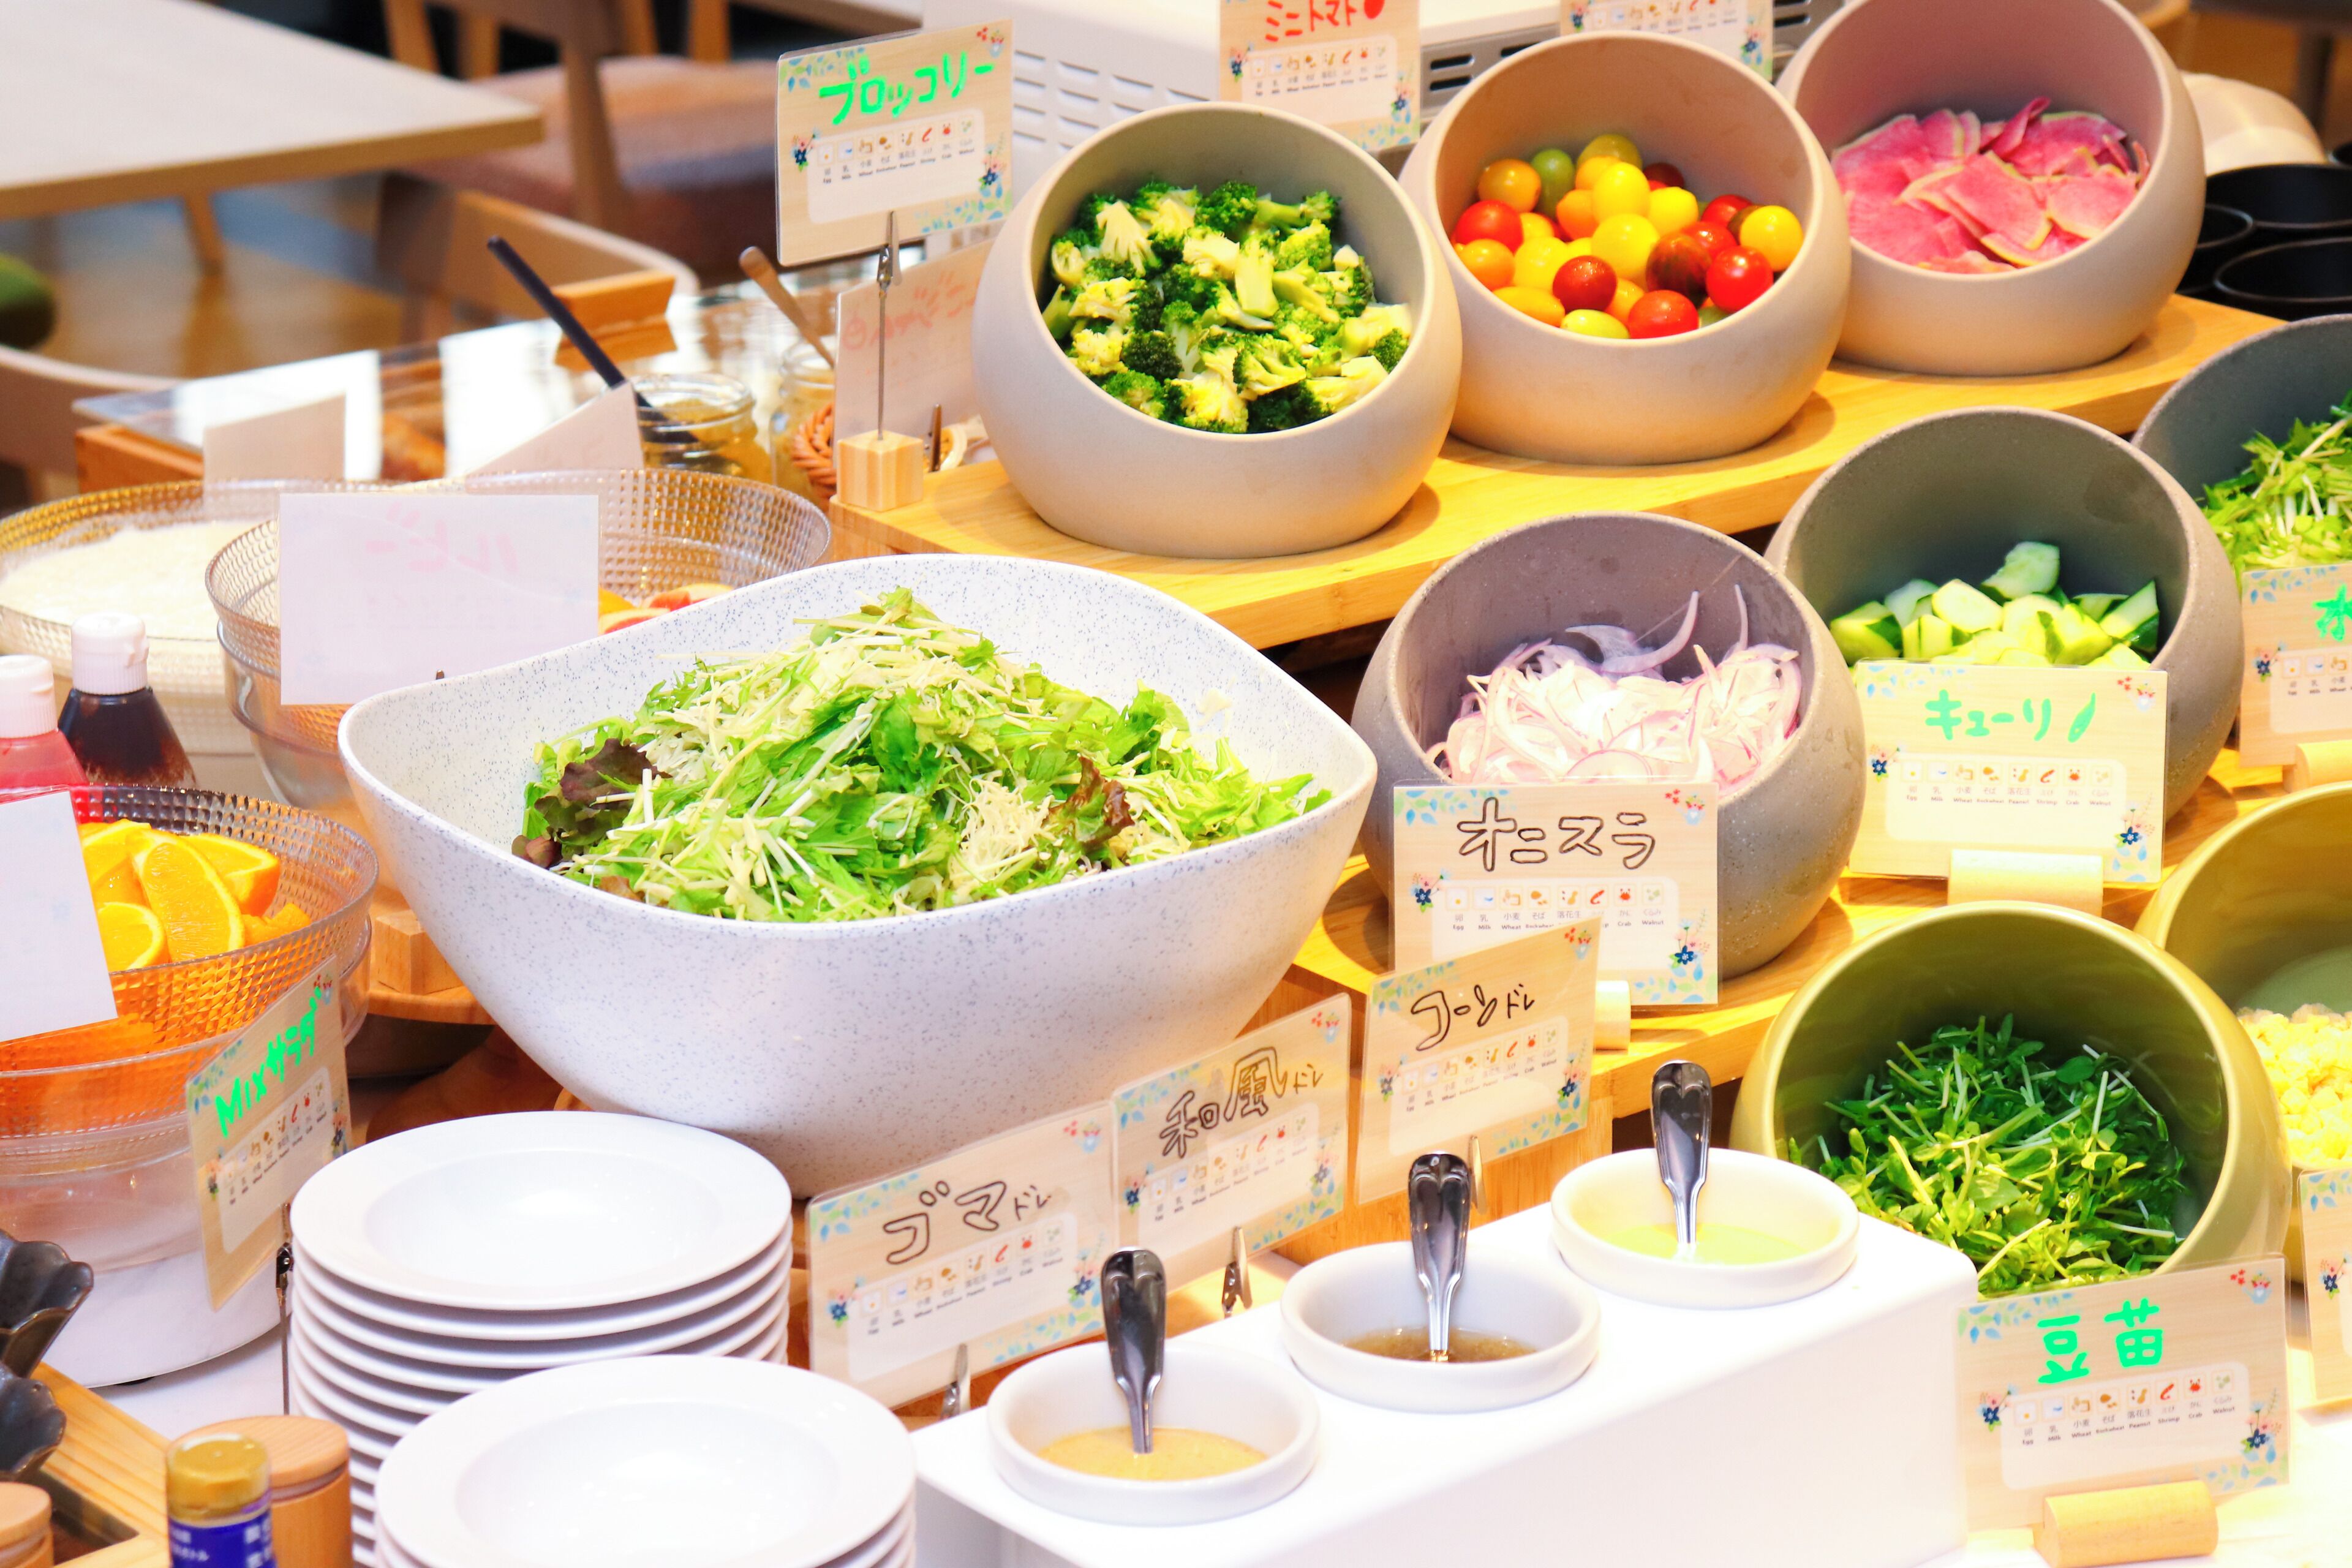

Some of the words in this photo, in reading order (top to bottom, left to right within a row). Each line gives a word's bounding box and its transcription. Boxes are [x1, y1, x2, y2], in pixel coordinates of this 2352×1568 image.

[818, 51, 995, 125] ブロッコリー
[1925, 689, 2052, 741] キューリ
[1457, 796, 1656, 872] オニスラ
[2035, 1297, 2165, 1385] 豆苗
[2071, 1430, 2092, 1439] Wheat
[2128, 1420, 2151, 1429] Peanut
[2158, 1415, 2180, 1425] Shrimp
[2212, 1406, 2235, 1415] Walnut
